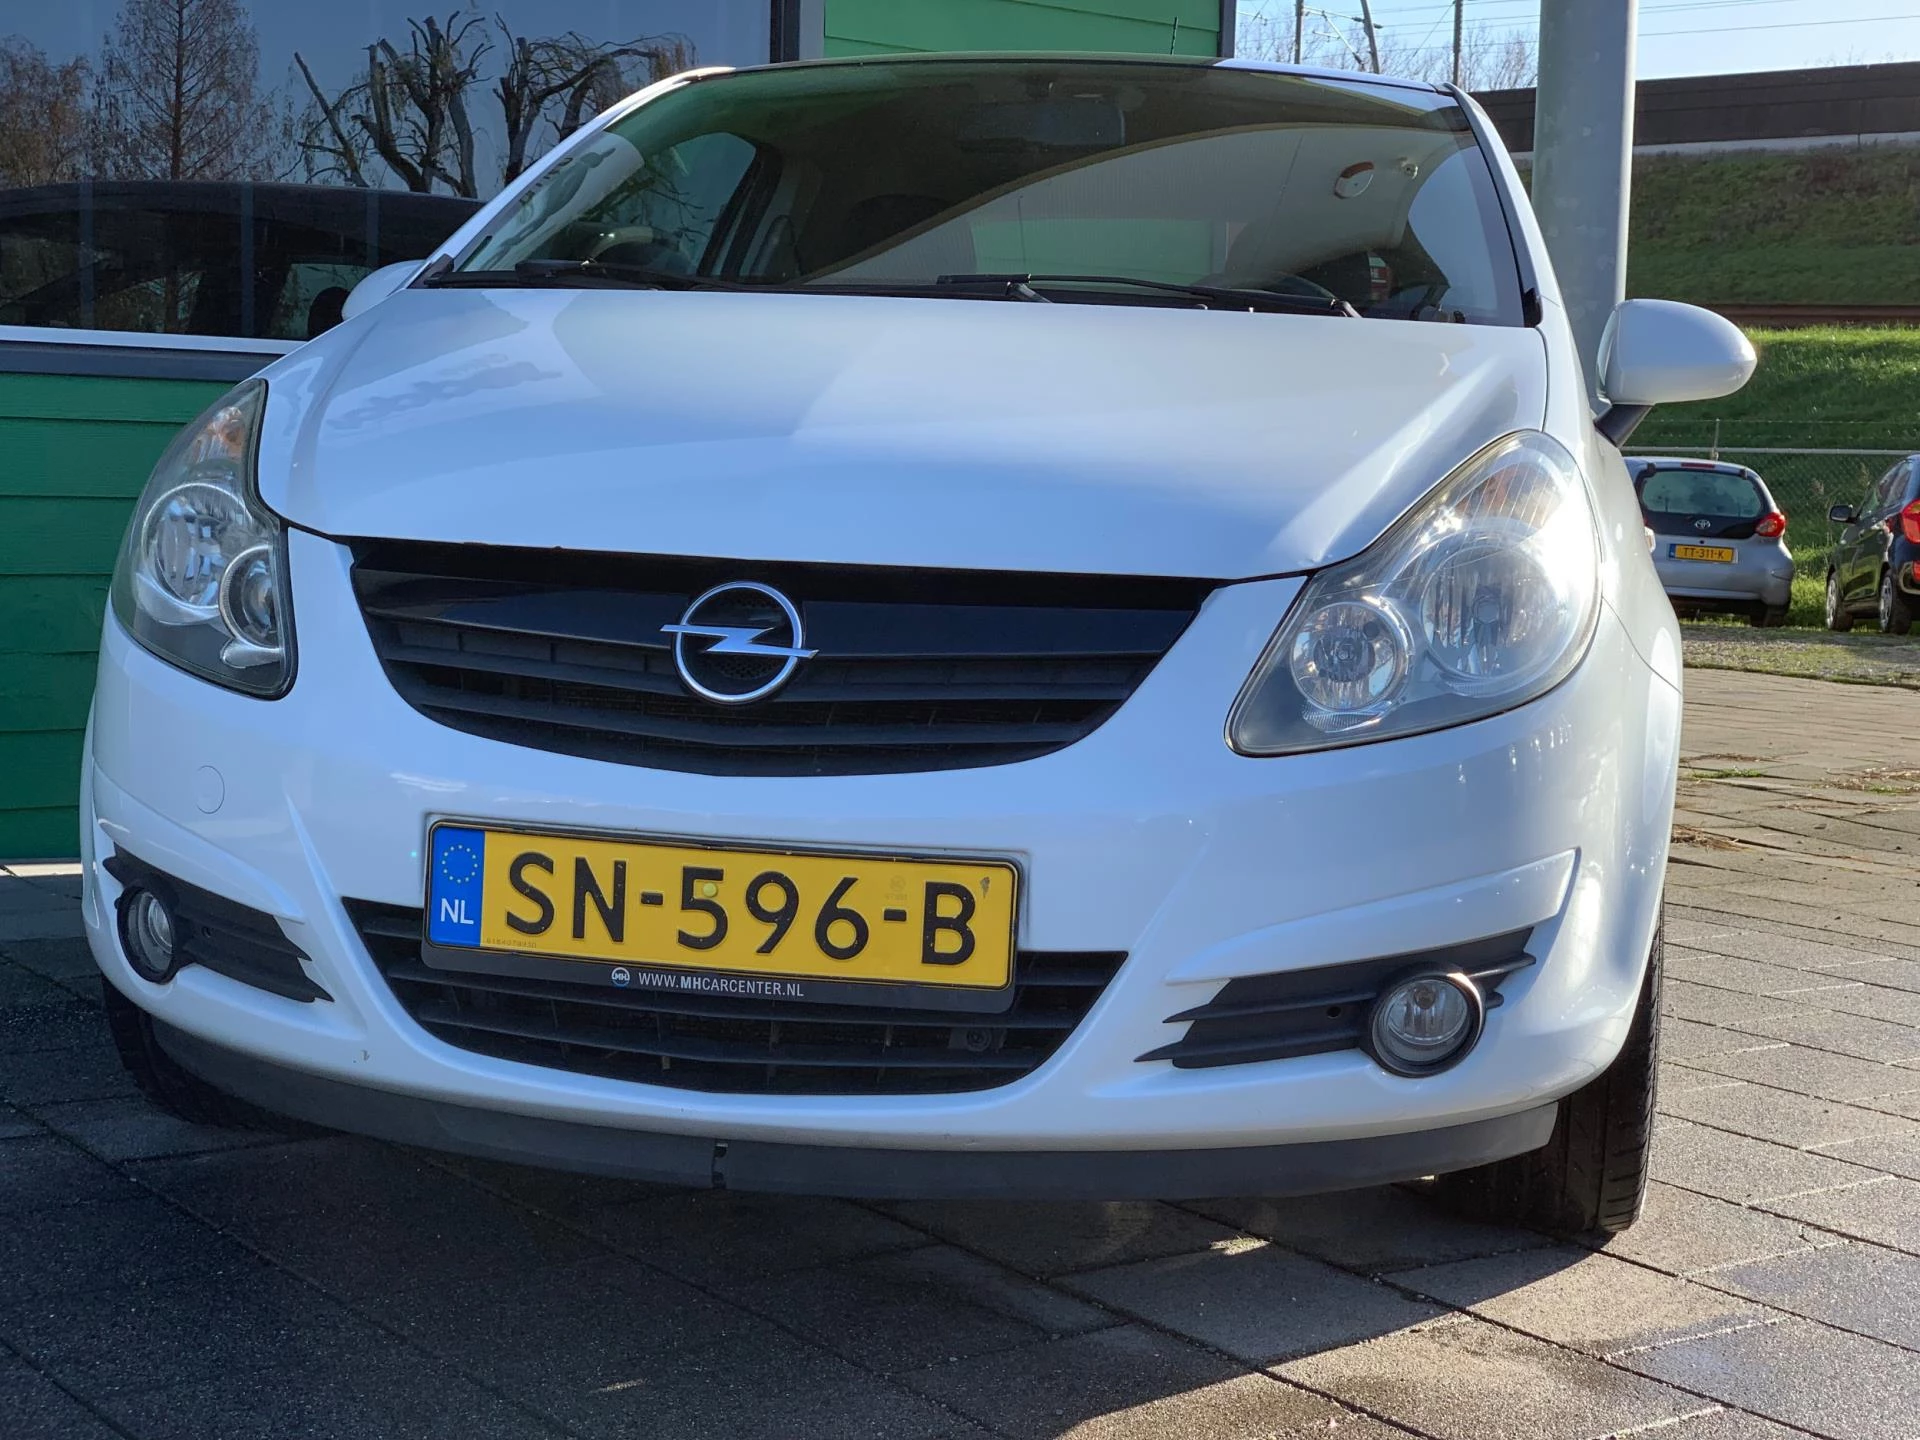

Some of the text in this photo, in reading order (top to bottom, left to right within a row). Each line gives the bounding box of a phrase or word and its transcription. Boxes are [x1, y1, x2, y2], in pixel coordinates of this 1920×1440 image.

[1682, 547, 1725, 560] TT-311-K
[440, 897, 475, 925] NL
[505, 850, 977, 966] SN-596-B
[638, 972, 804, 997] WWW.MHCARCENTER.NL
